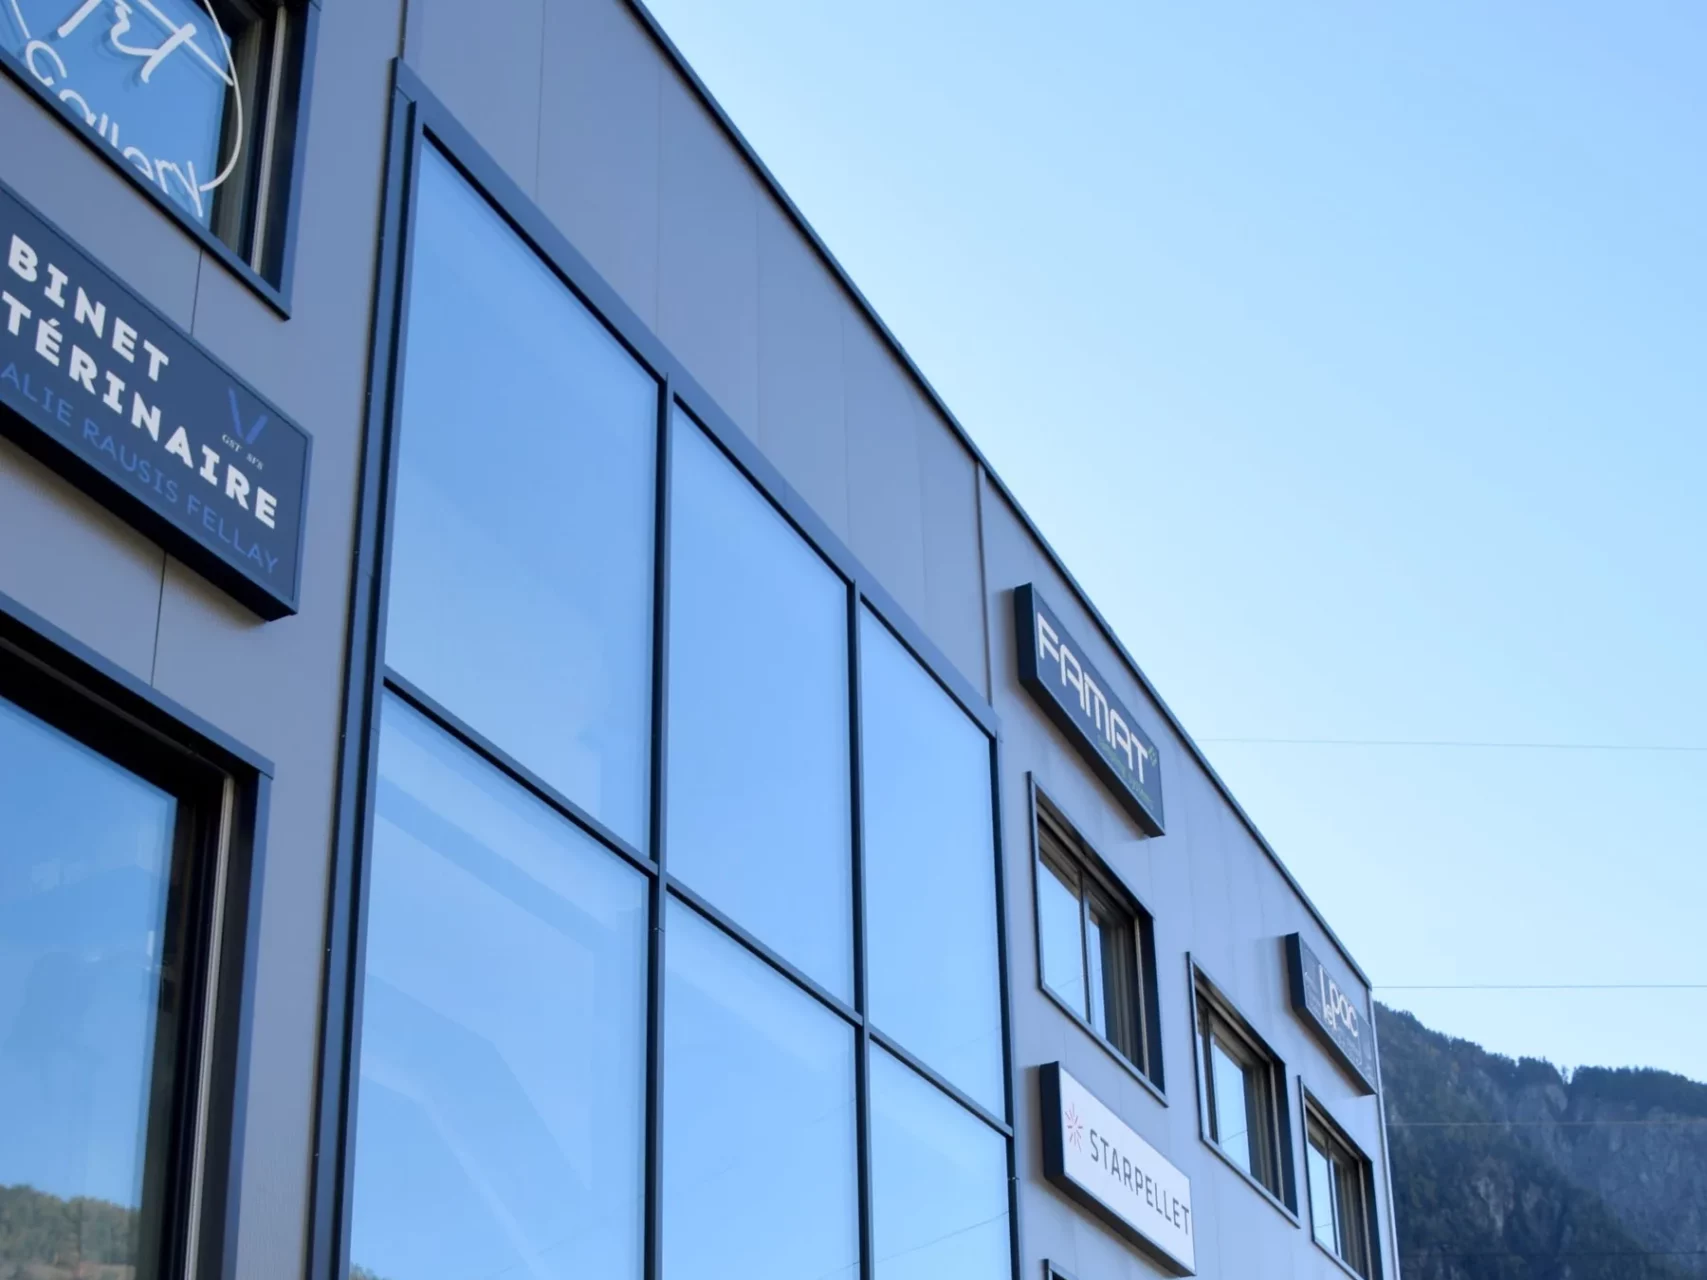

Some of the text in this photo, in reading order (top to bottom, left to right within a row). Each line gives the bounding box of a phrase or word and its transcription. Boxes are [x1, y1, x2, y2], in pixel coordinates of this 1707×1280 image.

[8, 233, 169, 382] BINET
[0, 361, 279, 575] ALIE RAUSIS FELLAY
[2, 290, 278, 530] TÉRINAIRE
[222, 433, 242, 452] GST
[1037, 612, 1149, 784] FAMAT
[1089, 1128, 1190, 1236] STARPELLET
